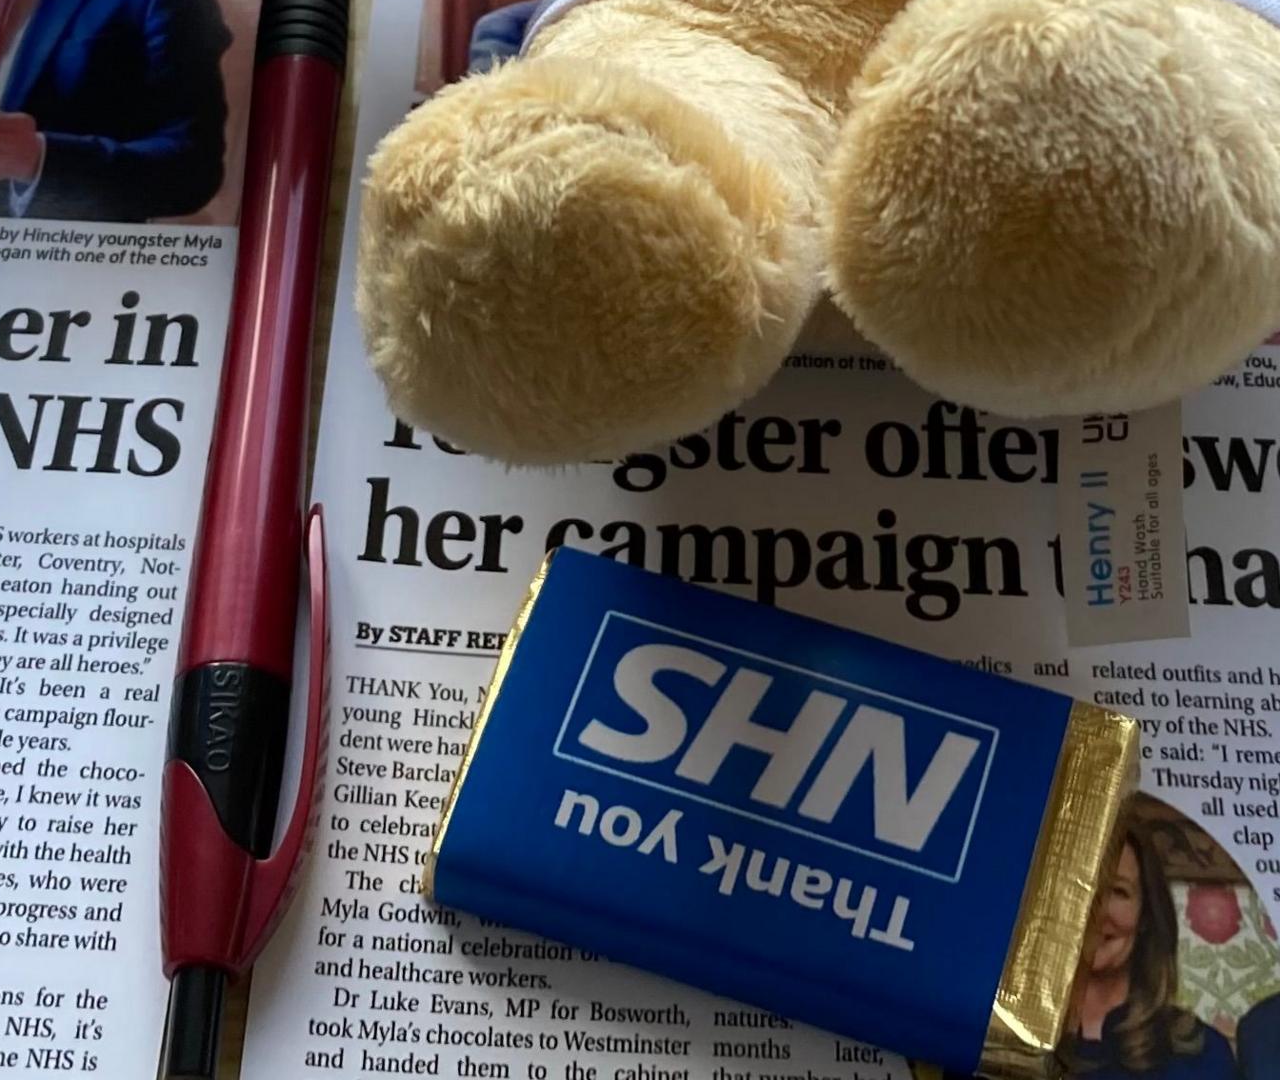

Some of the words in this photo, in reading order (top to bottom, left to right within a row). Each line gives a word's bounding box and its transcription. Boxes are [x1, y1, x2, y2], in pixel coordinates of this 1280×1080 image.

[23, 228, 94, 248] Hinckley
[98, 233, 181, 250] youngster
[184, 234, 222, 251] Myla
[36, 247, 71, 262] with
[74, 251, 106, 263] one
[109, 250, 127, 264] of
[130, 250, 157, 265] the
[160, 252, 208, 267] chocs
[103, 288, 200, 369] in
[1148, 453, 1160, 485] ages
[1146, 492, 1159, 510] all
[8, 528, 79, 546] workers
[83, 534, 100, 547] at
[104, 531, 185, 554] hospitals
[356, 476, 523, 574] her
[1148, 514, 1160, 534] for
[38, 553, 125, 577] Coventry,
[141, 557, 180, 575] Not-
[1087, 502, 1115, 606] Henry
[1148, 538, 1164, 600] Suitable
[1118, 566, 1131, 606] Y243
[1134, 559, 1149, 601] Hand
[356, 622, 384, 645] By
[389, 625, 462, 647] STAFF
[1094, 688, 1145, 706] cated
[1151, 692, 1169, 707] to
[1175, 689, 1255, 716] learning
[578, 642, 982, 851] NHS
[554, 788, 682, 865] you
[699, 832, 917, 951] Thank
[315, 957, 353, 978] and
[358, 958, 463, 985] healthcare
[468, 968, 551, 989] workers.
[334, 987, 360, 1008] Dr
[370, 990, 419, 1012] Luke
[430, 994, 493, 1018] Evans,
[506, 997, 540, 1018] MP
[551, 999, 579, 1020] for
[590, 1001, 690, 1027] Bosworth,
